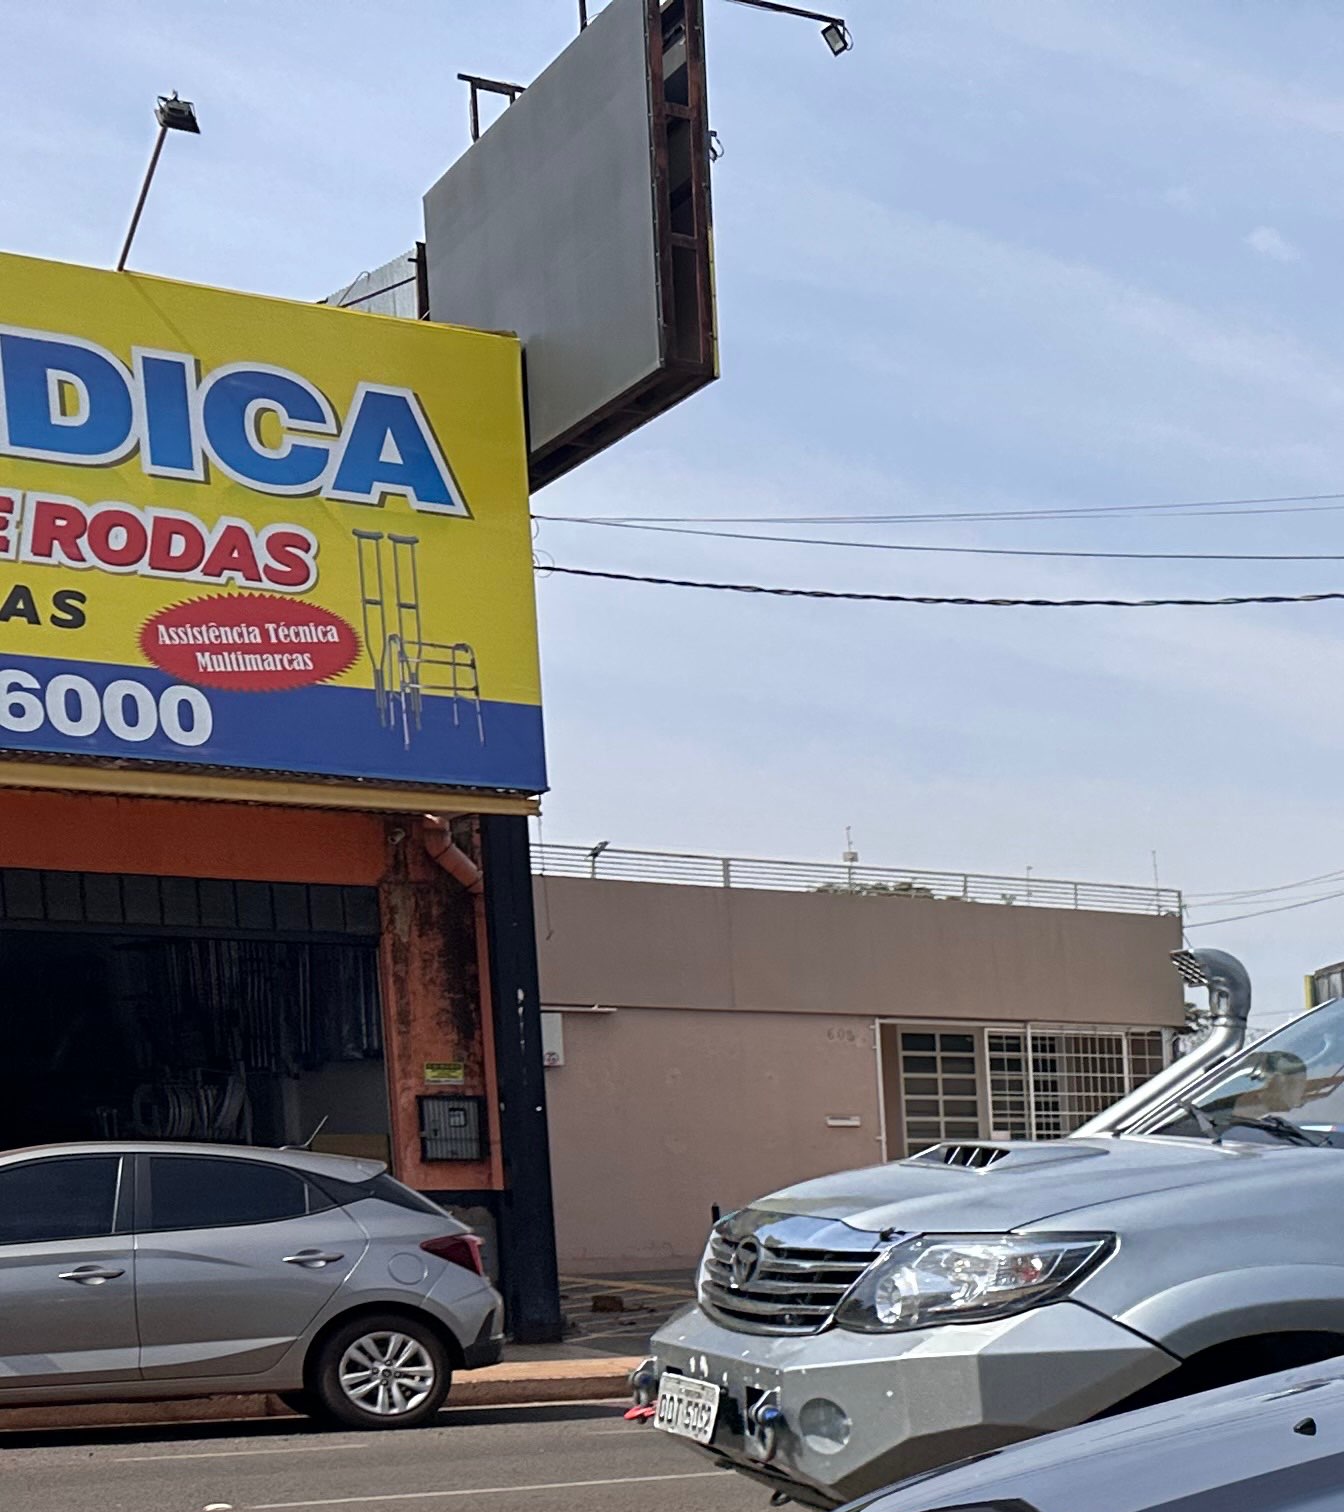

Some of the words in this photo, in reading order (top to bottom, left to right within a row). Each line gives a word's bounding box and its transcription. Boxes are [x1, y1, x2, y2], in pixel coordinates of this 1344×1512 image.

[0, 328, 470, 516] DICA
[27, 496, 315, 590] RODAS
[0, 584, 87, 630] AS
[158, 622, 262, 645] Assistência
[264, 622, 340, 643] Técnica
[195, 652, 314, 673] Multimarcas
[0, 668, 213, 747] 6000
